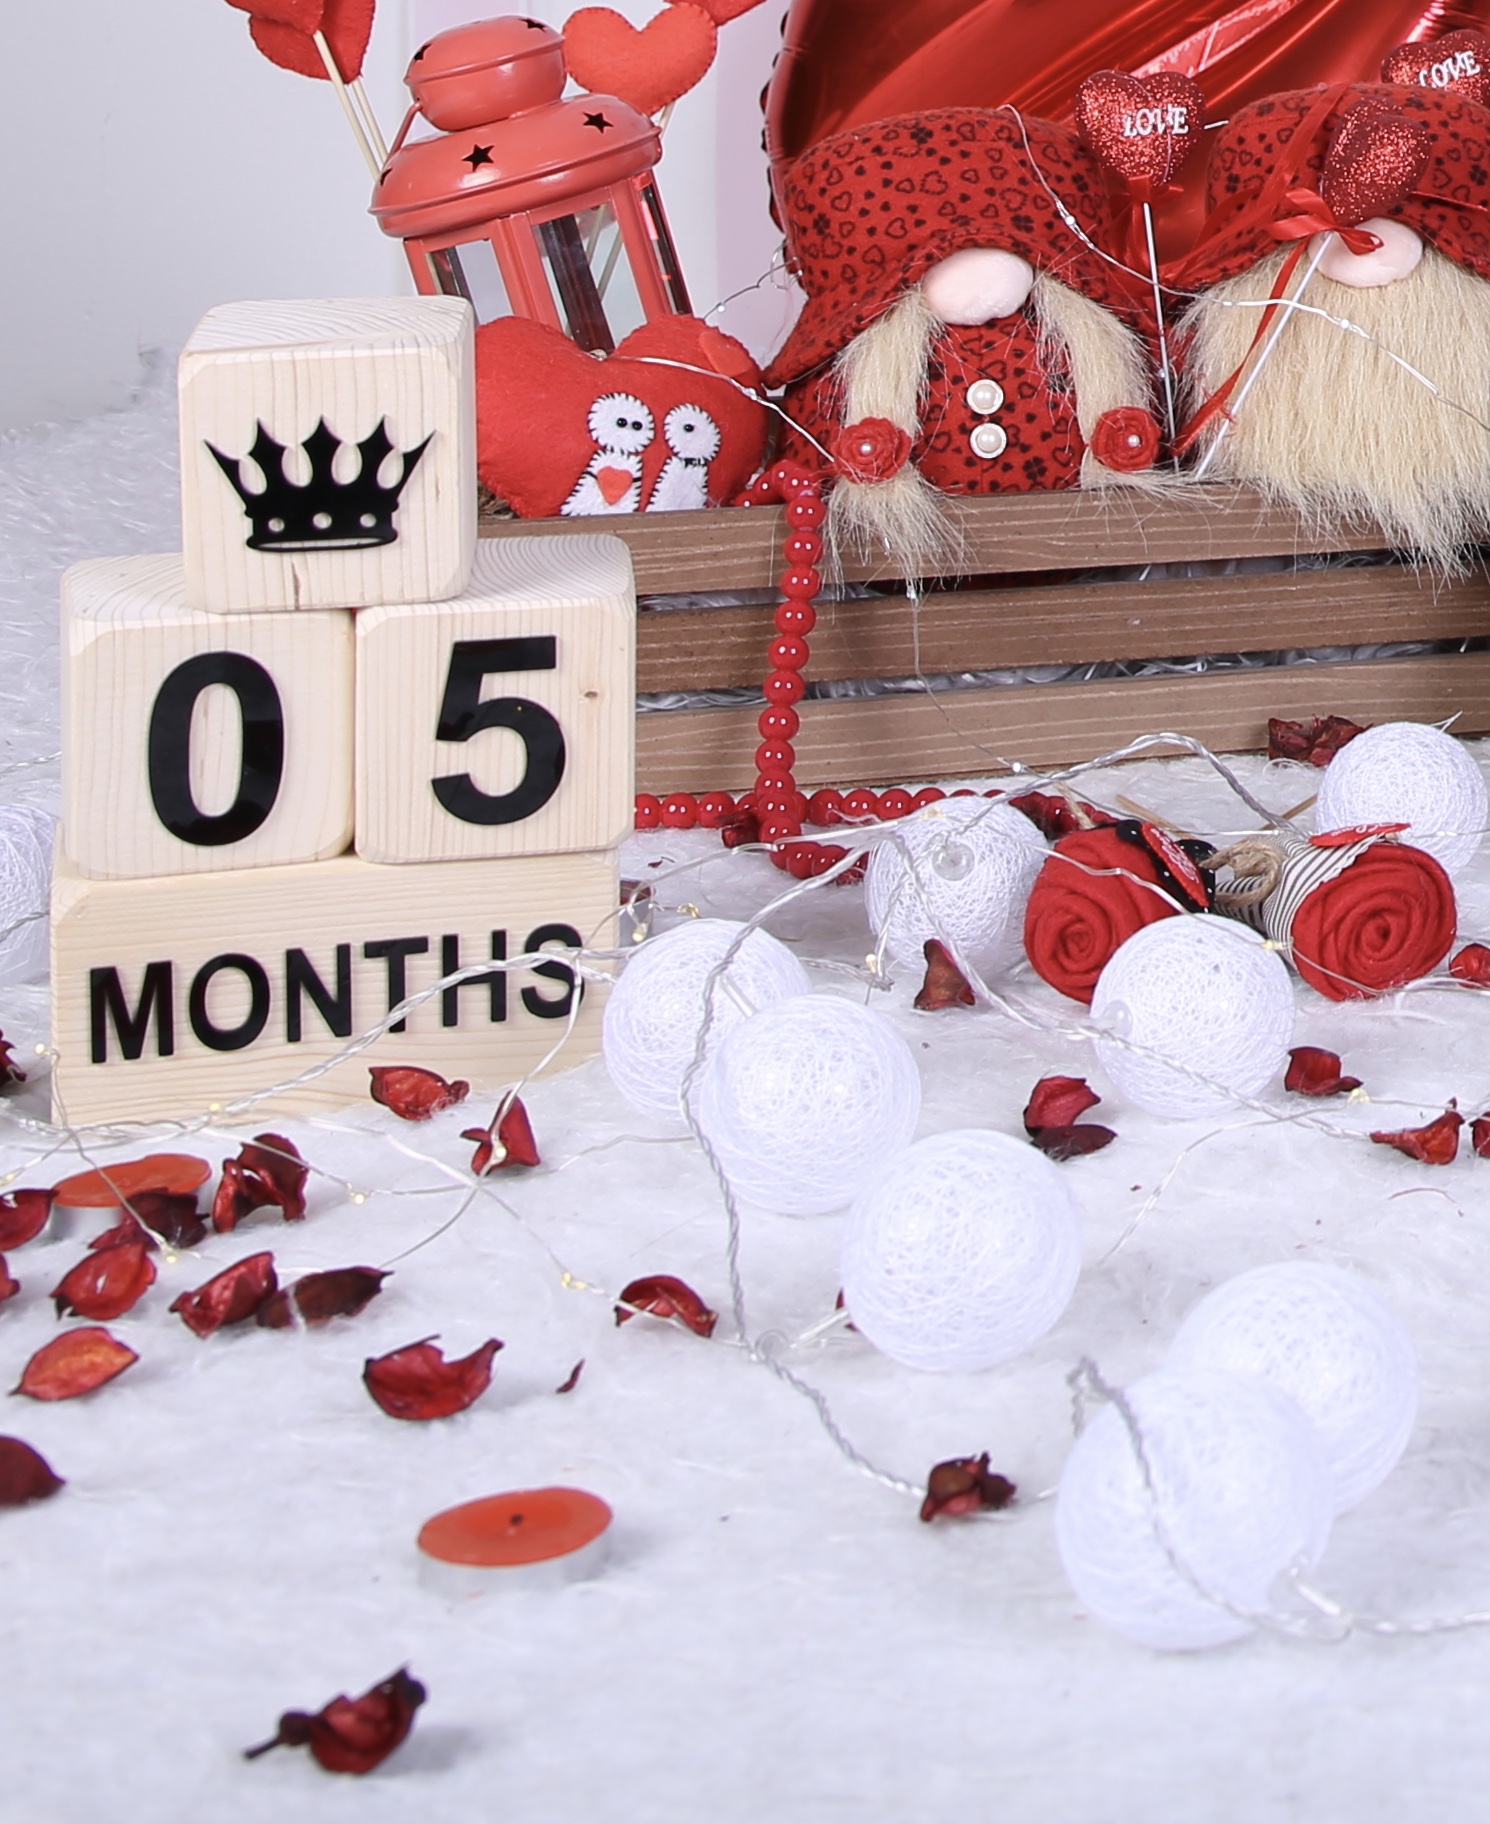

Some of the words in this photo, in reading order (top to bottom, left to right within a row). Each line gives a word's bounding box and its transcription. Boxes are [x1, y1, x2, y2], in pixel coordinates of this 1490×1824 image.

[1418, 50, 1481, 89] LOVE
[1123, 103, 1189, 137] LOVE
[90, 924, 584, 1064] MONTHS
